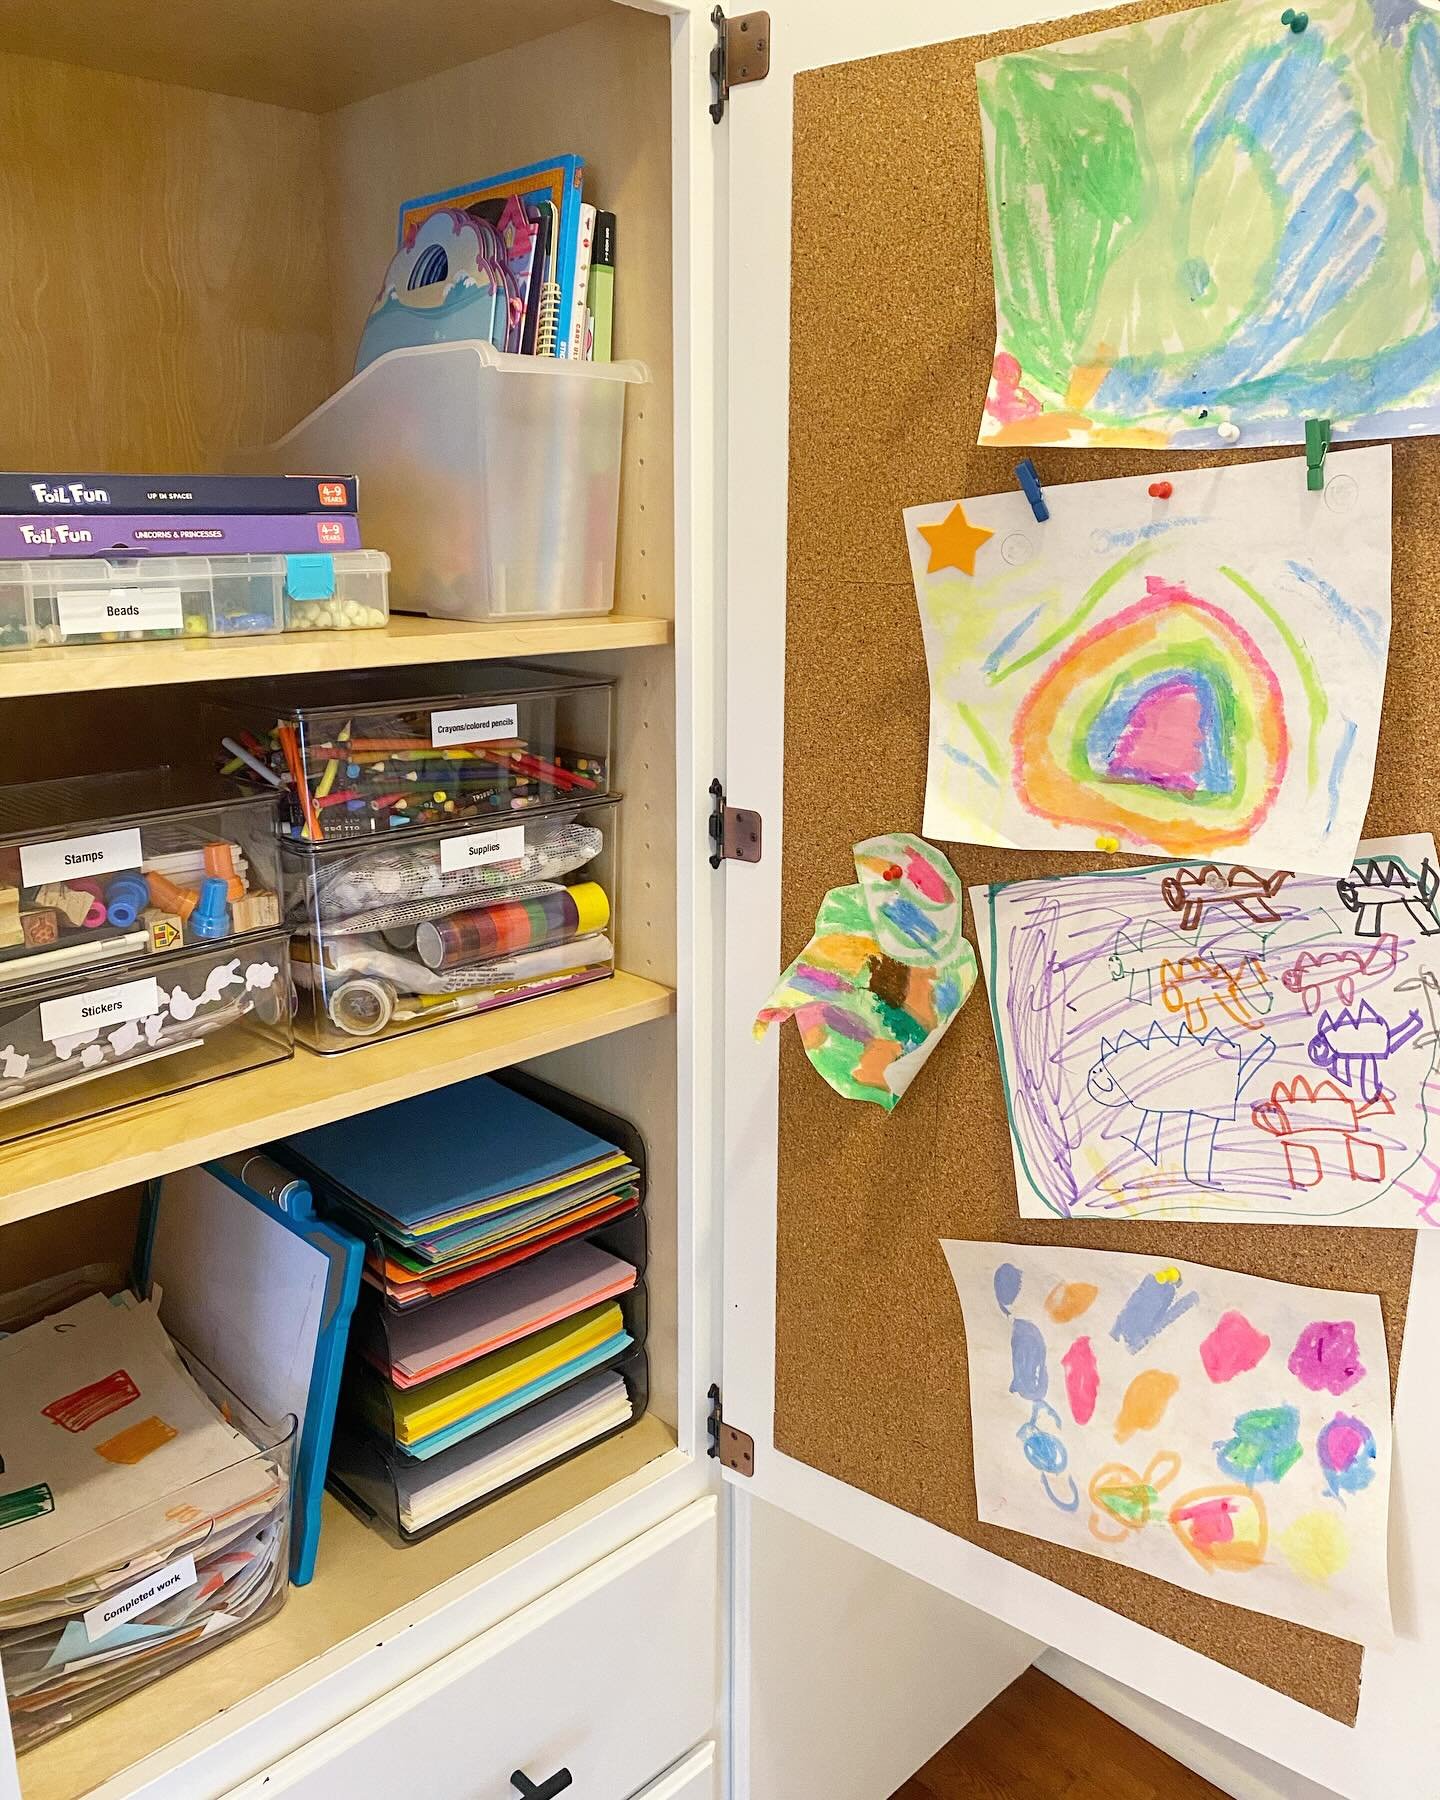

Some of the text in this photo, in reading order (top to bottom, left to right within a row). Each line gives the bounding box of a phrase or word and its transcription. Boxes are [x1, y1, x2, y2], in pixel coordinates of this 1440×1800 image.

[180, 530, 223, 538] PRINCESSES
[107, 605, 140, 617] Beads
[437, 717, 514, 733] Crayons/colored pencils
[468, 841, 500, 856] Supplies
[64, 850, 104, 866] Stamps
[81, 1000, 123, 1018] Stickers
[103, 1574, 181, 1622] Completed work
